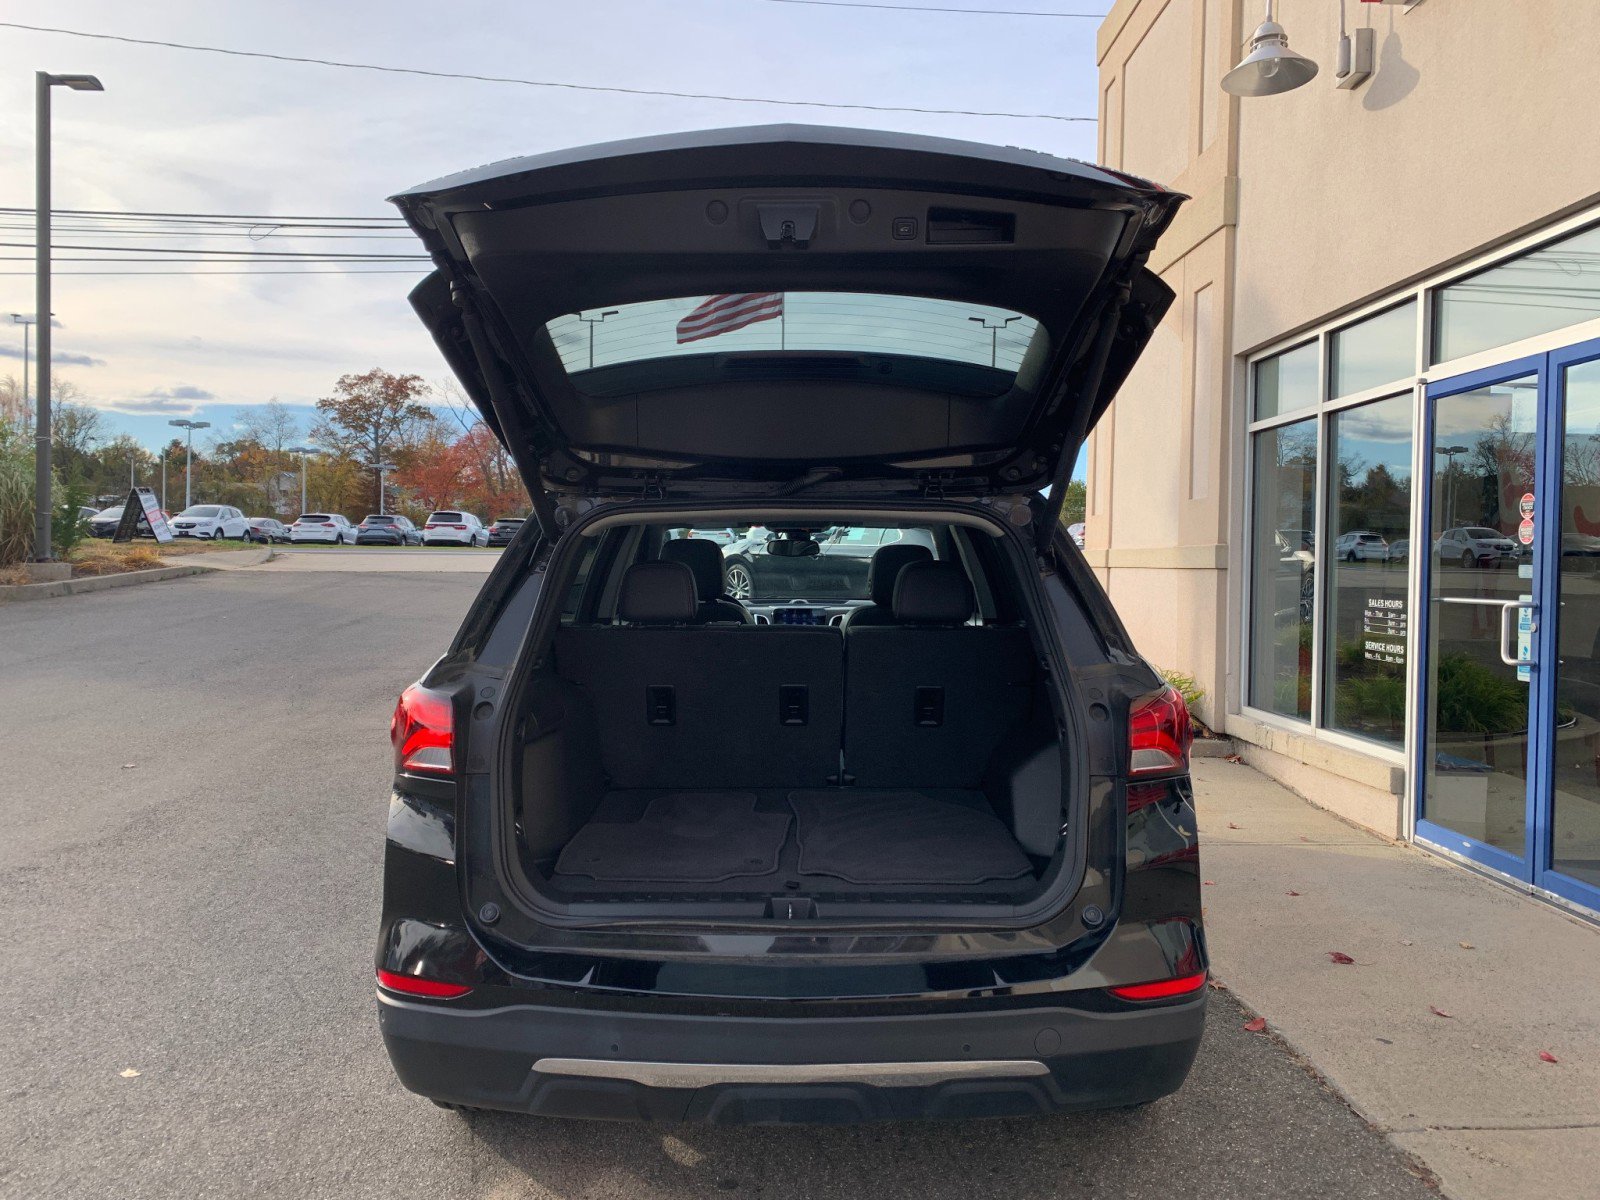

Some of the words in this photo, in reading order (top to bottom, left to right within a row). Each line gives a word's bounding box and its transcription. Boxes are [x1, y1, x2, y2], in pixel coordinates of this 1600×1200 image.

[1368, 598, 1384, 607] SALES
[1385, 600, 1403, 608] HOURS
[1365, 641, 1385, 651] SERVICE
[1386, 644, 1404, 654] HOURS
